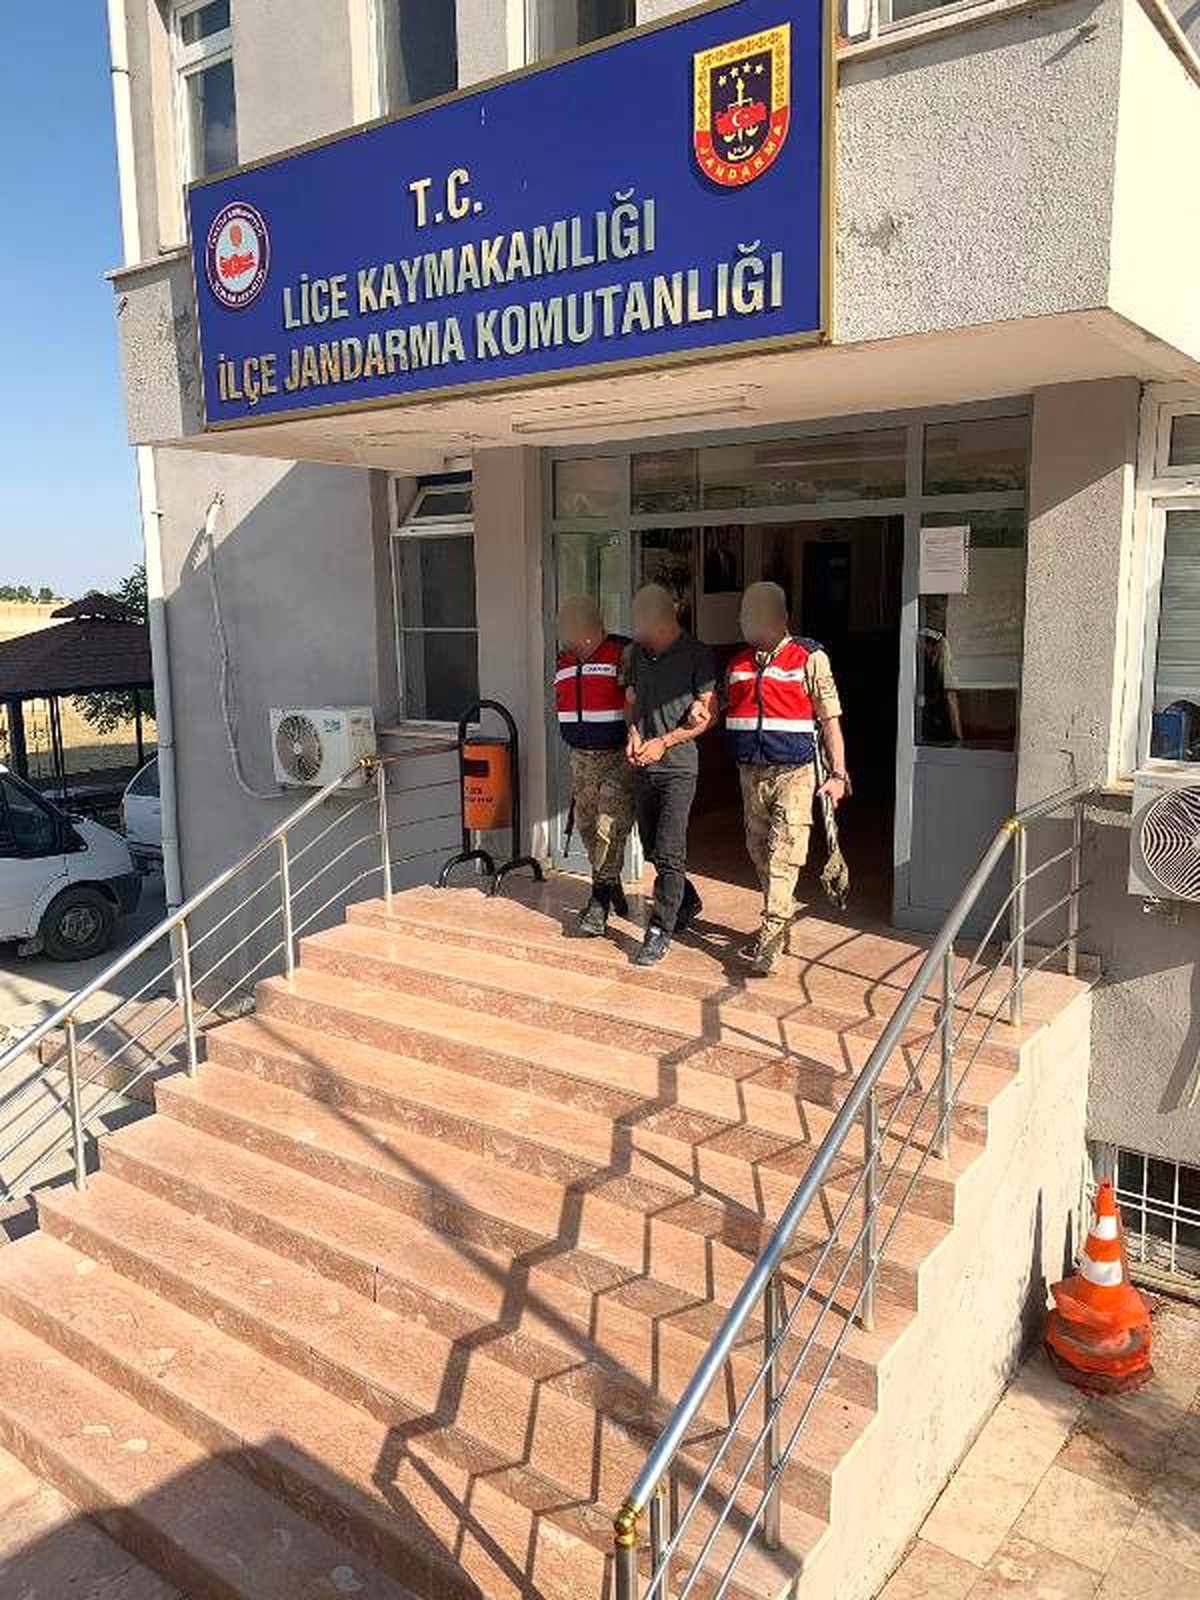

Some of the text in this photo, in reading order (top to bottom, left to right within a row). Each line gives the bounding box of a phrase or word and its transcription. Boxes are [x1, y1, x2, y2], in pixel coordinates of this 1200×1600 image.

[410, 168, 482, 227] T.C.
[700, 125, 783, 178] JANDARMA
[283, 273, 350, 330] LİCE
[357, 187, 655, 314] KAYMAKAMLIĞI
[218, 240, 783, 406] İLÇE JANDARMA KOMUTANLIĞI
